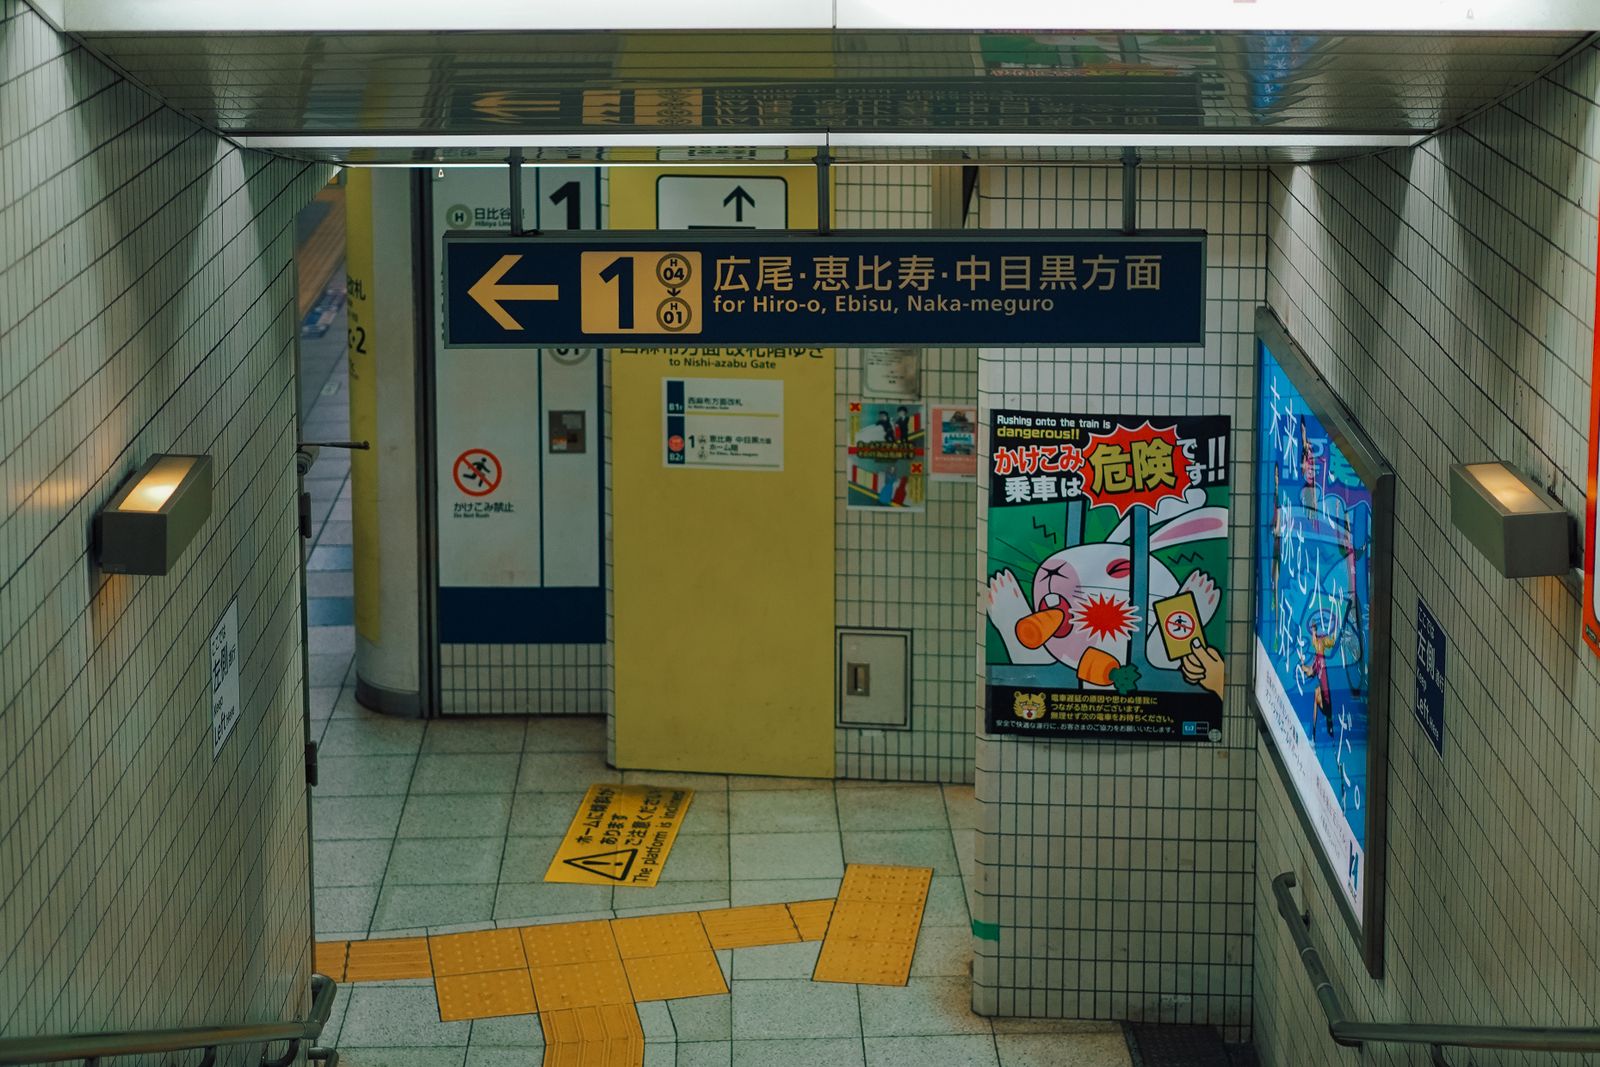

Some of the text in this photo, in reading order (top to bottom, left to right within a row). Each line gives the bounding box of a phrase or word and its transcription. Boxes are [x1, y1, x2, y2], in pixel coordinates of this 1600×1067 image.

[549, 180, 581, 231] 1
[474, 207, 525, 221] 日比谷
[669, 258, 679, 268] H
[663, 267, 686, 281] 04
[598, 256, 635, 330] 1
[669, 302, 679, 311] H
[713, 295, 1055, 316] for Hiro-o, Ebisu, Naka-meguro
[663, 311, 685, 325] 01
[669, 358, 777, 370] to Nishi-azabu Gate
[996, 414, 1032, 427] Rushing
[1035, 418, 1057, 427] onto
[1060, 418, 1076, 428] the
[1079, 419, 1100, 429] train
[996, 426, 1080, 440] dangerous!!
[688, 435, 696, 449] 1
[994, 444, 1086, 476] かけこみ
[1087, 437, 1178, 496] 危険
[1005, 475, 1083, 503] 乗車は
[599, 812, 629, 845] あります
[639, 831, 669, 866] platform
[632, 868, 653, 884] The
